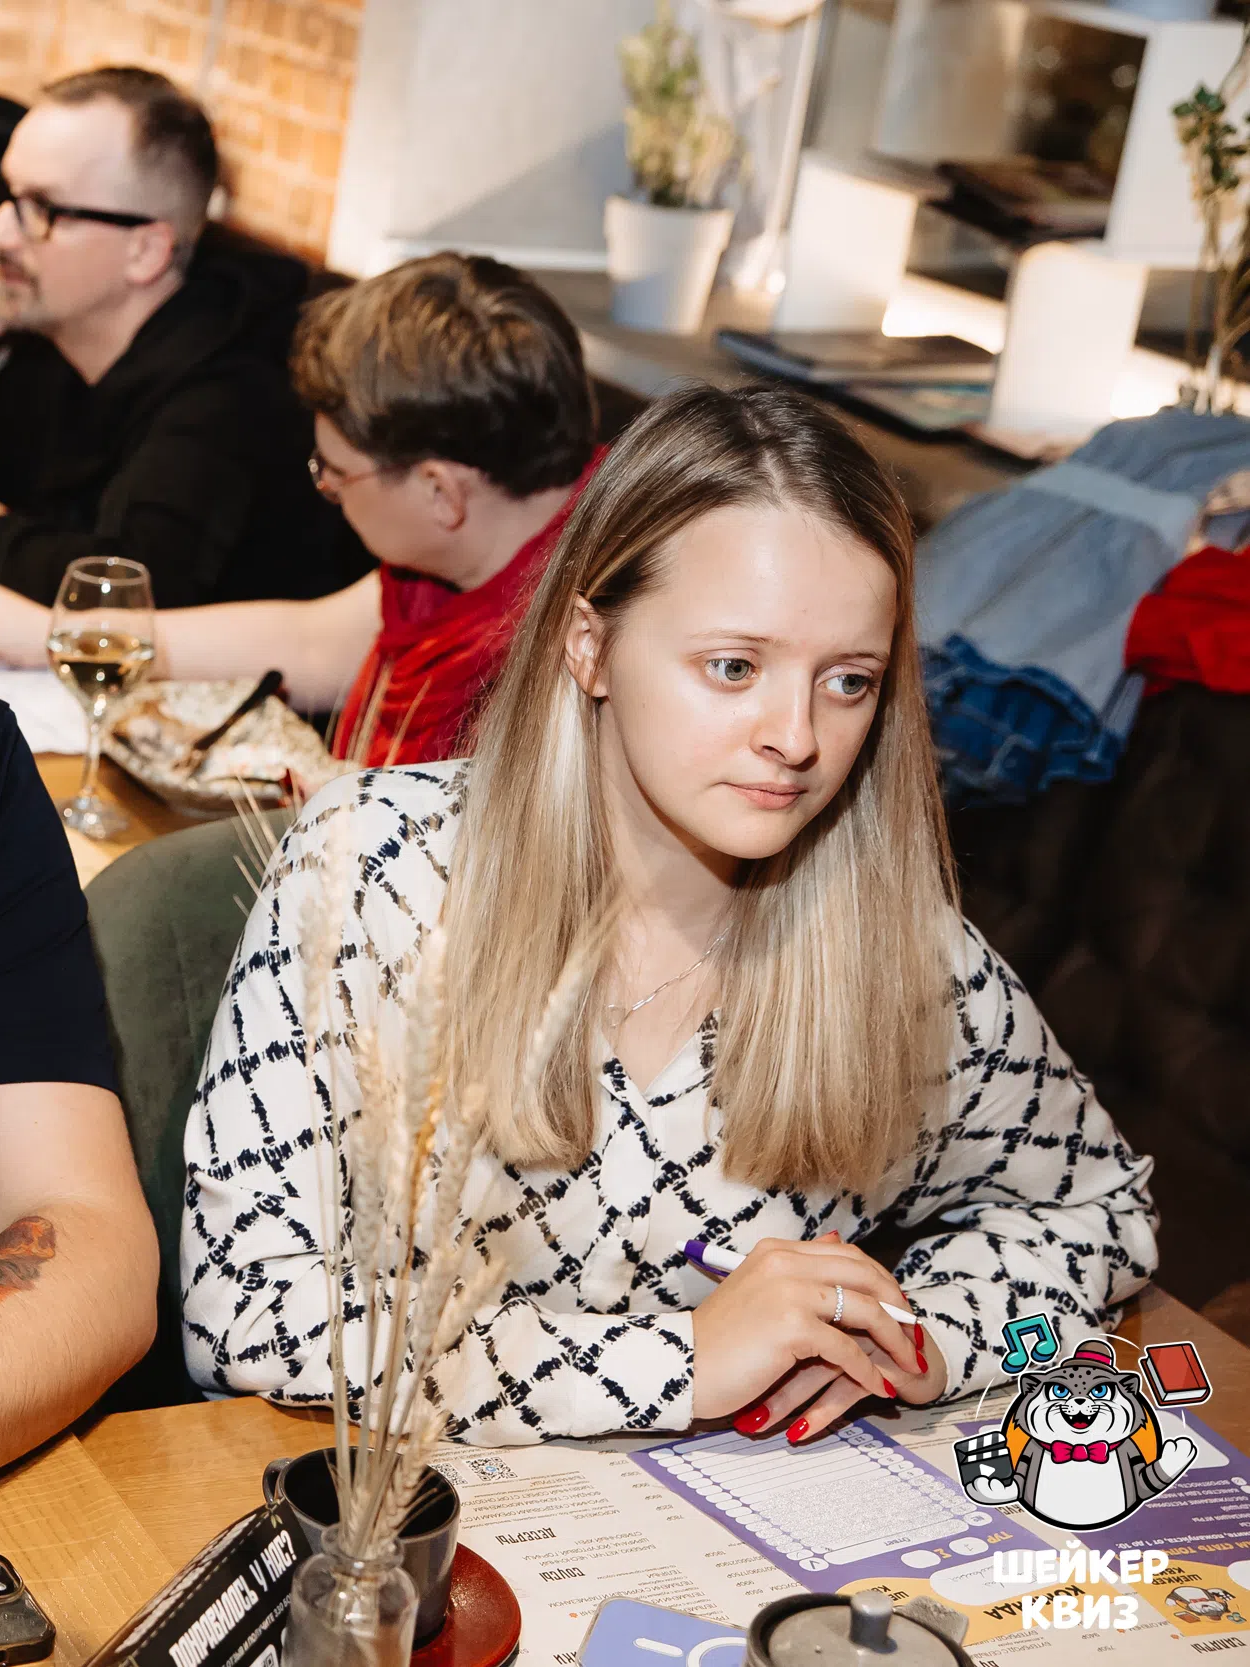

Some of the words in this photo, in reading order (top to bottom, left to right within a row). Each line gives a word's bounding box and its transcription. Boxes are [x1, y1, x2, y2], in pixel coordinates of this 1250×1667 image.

[496, 1528, 556, 1544] ДЕСЕРТЫ
[987, 1531, 1013, 1543] ТУР
[1164, 1534, 1224, 1543] пожалуйста,
[1198, 1543, 1233, 1551] СТАТЬ
[249, 1560, 268, 1592] У
[261, 1530, 297, 1582] НАС?
[539, 1567, 585, 1582] СОУСЫ
[1152, 1574, 1202, 1585] ШЕЙКЕР
[983, 1584, 1086, 1620] КОМНДА
[1192, 1637, 1246, 1653] САЛАТЫ
